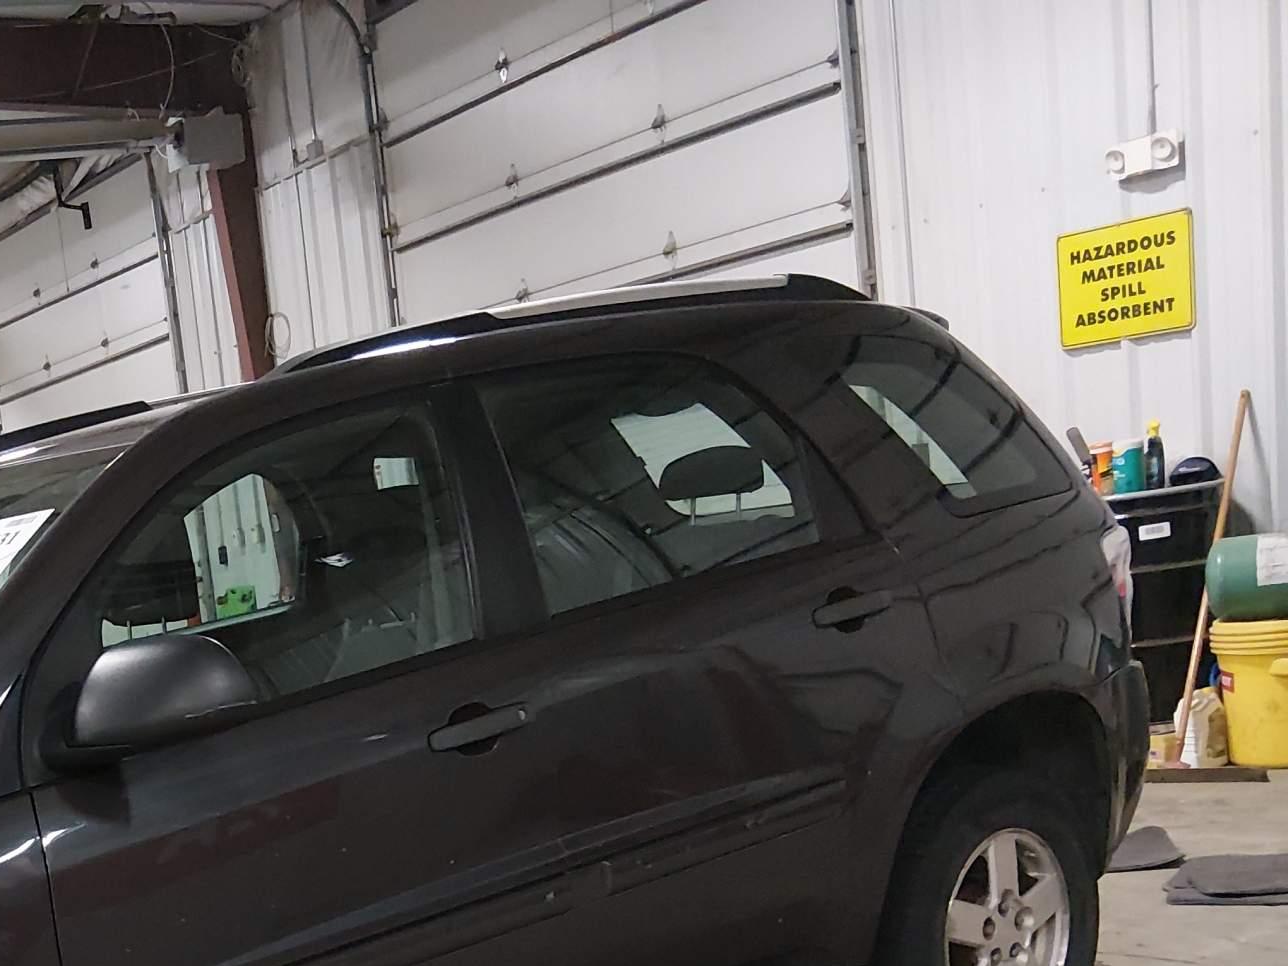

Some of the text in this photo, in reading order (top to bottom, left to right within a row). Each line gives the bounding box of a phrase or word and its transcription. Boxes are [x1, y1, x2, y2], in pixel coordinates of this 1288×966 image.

[1070, 231, 1175, 265] HAZARDOUS
[1081, 256, 1165, 284] MATERIAL
[1100, 282, 1146, 301] SPILL
[1075, 298, 1175, 328] ABSORBENT
